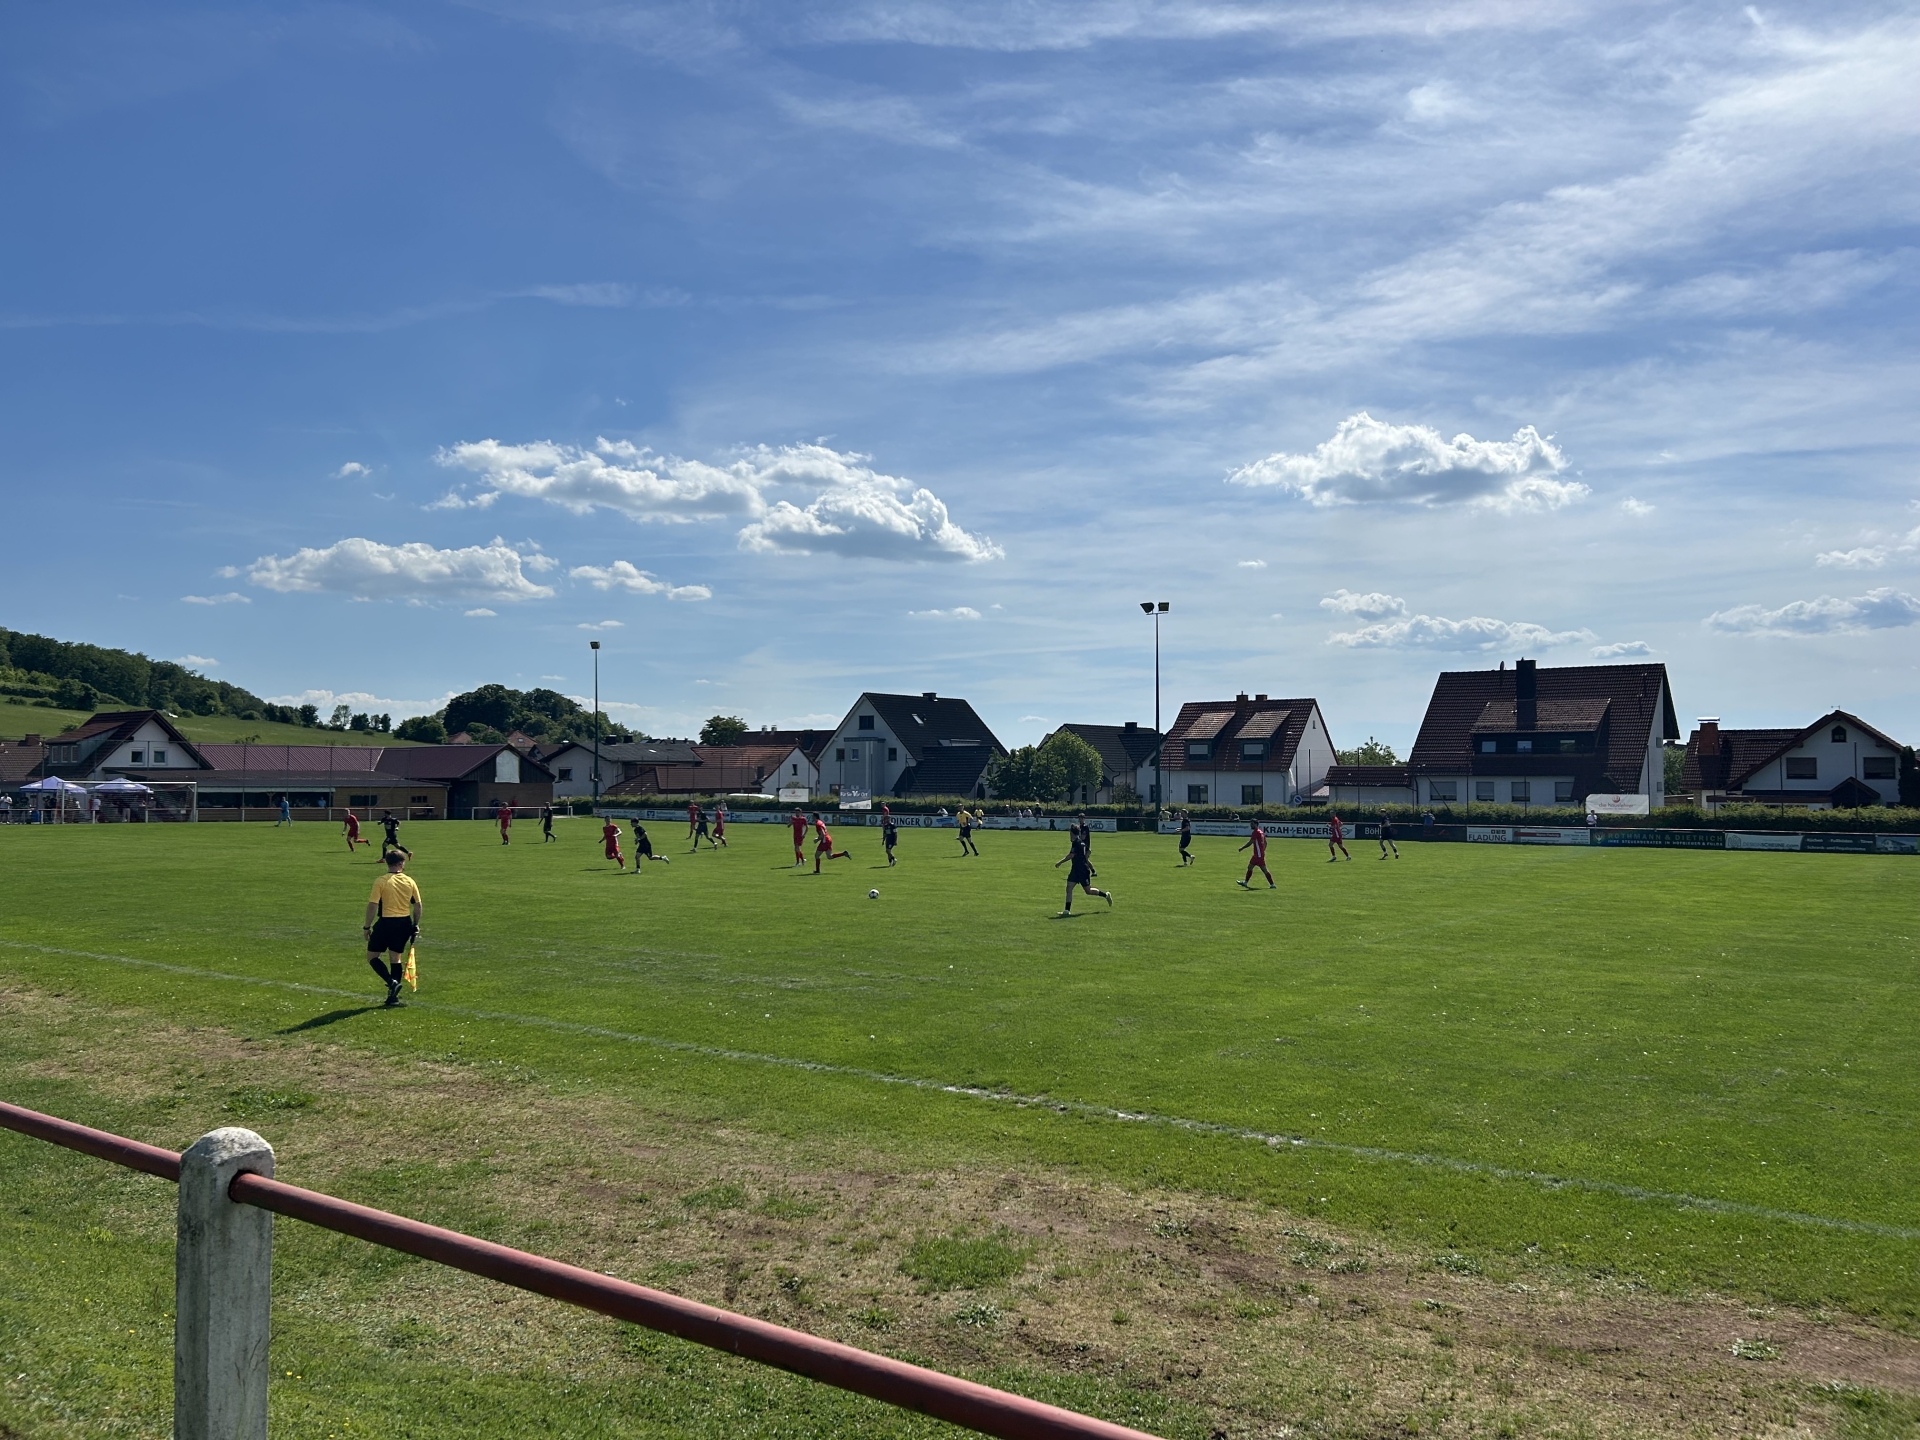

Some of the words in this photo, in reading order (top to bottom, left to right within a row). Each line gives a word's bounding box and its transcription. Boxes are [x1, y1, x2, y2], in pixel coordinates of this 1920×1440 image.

[882, 816, 921, 827] DINGER
[1263, 826, 1290, 834] KRAH
[1468, 834, 1507, 842] FLADUNG
[1674, 834, 1723, 842] DIETRICH
